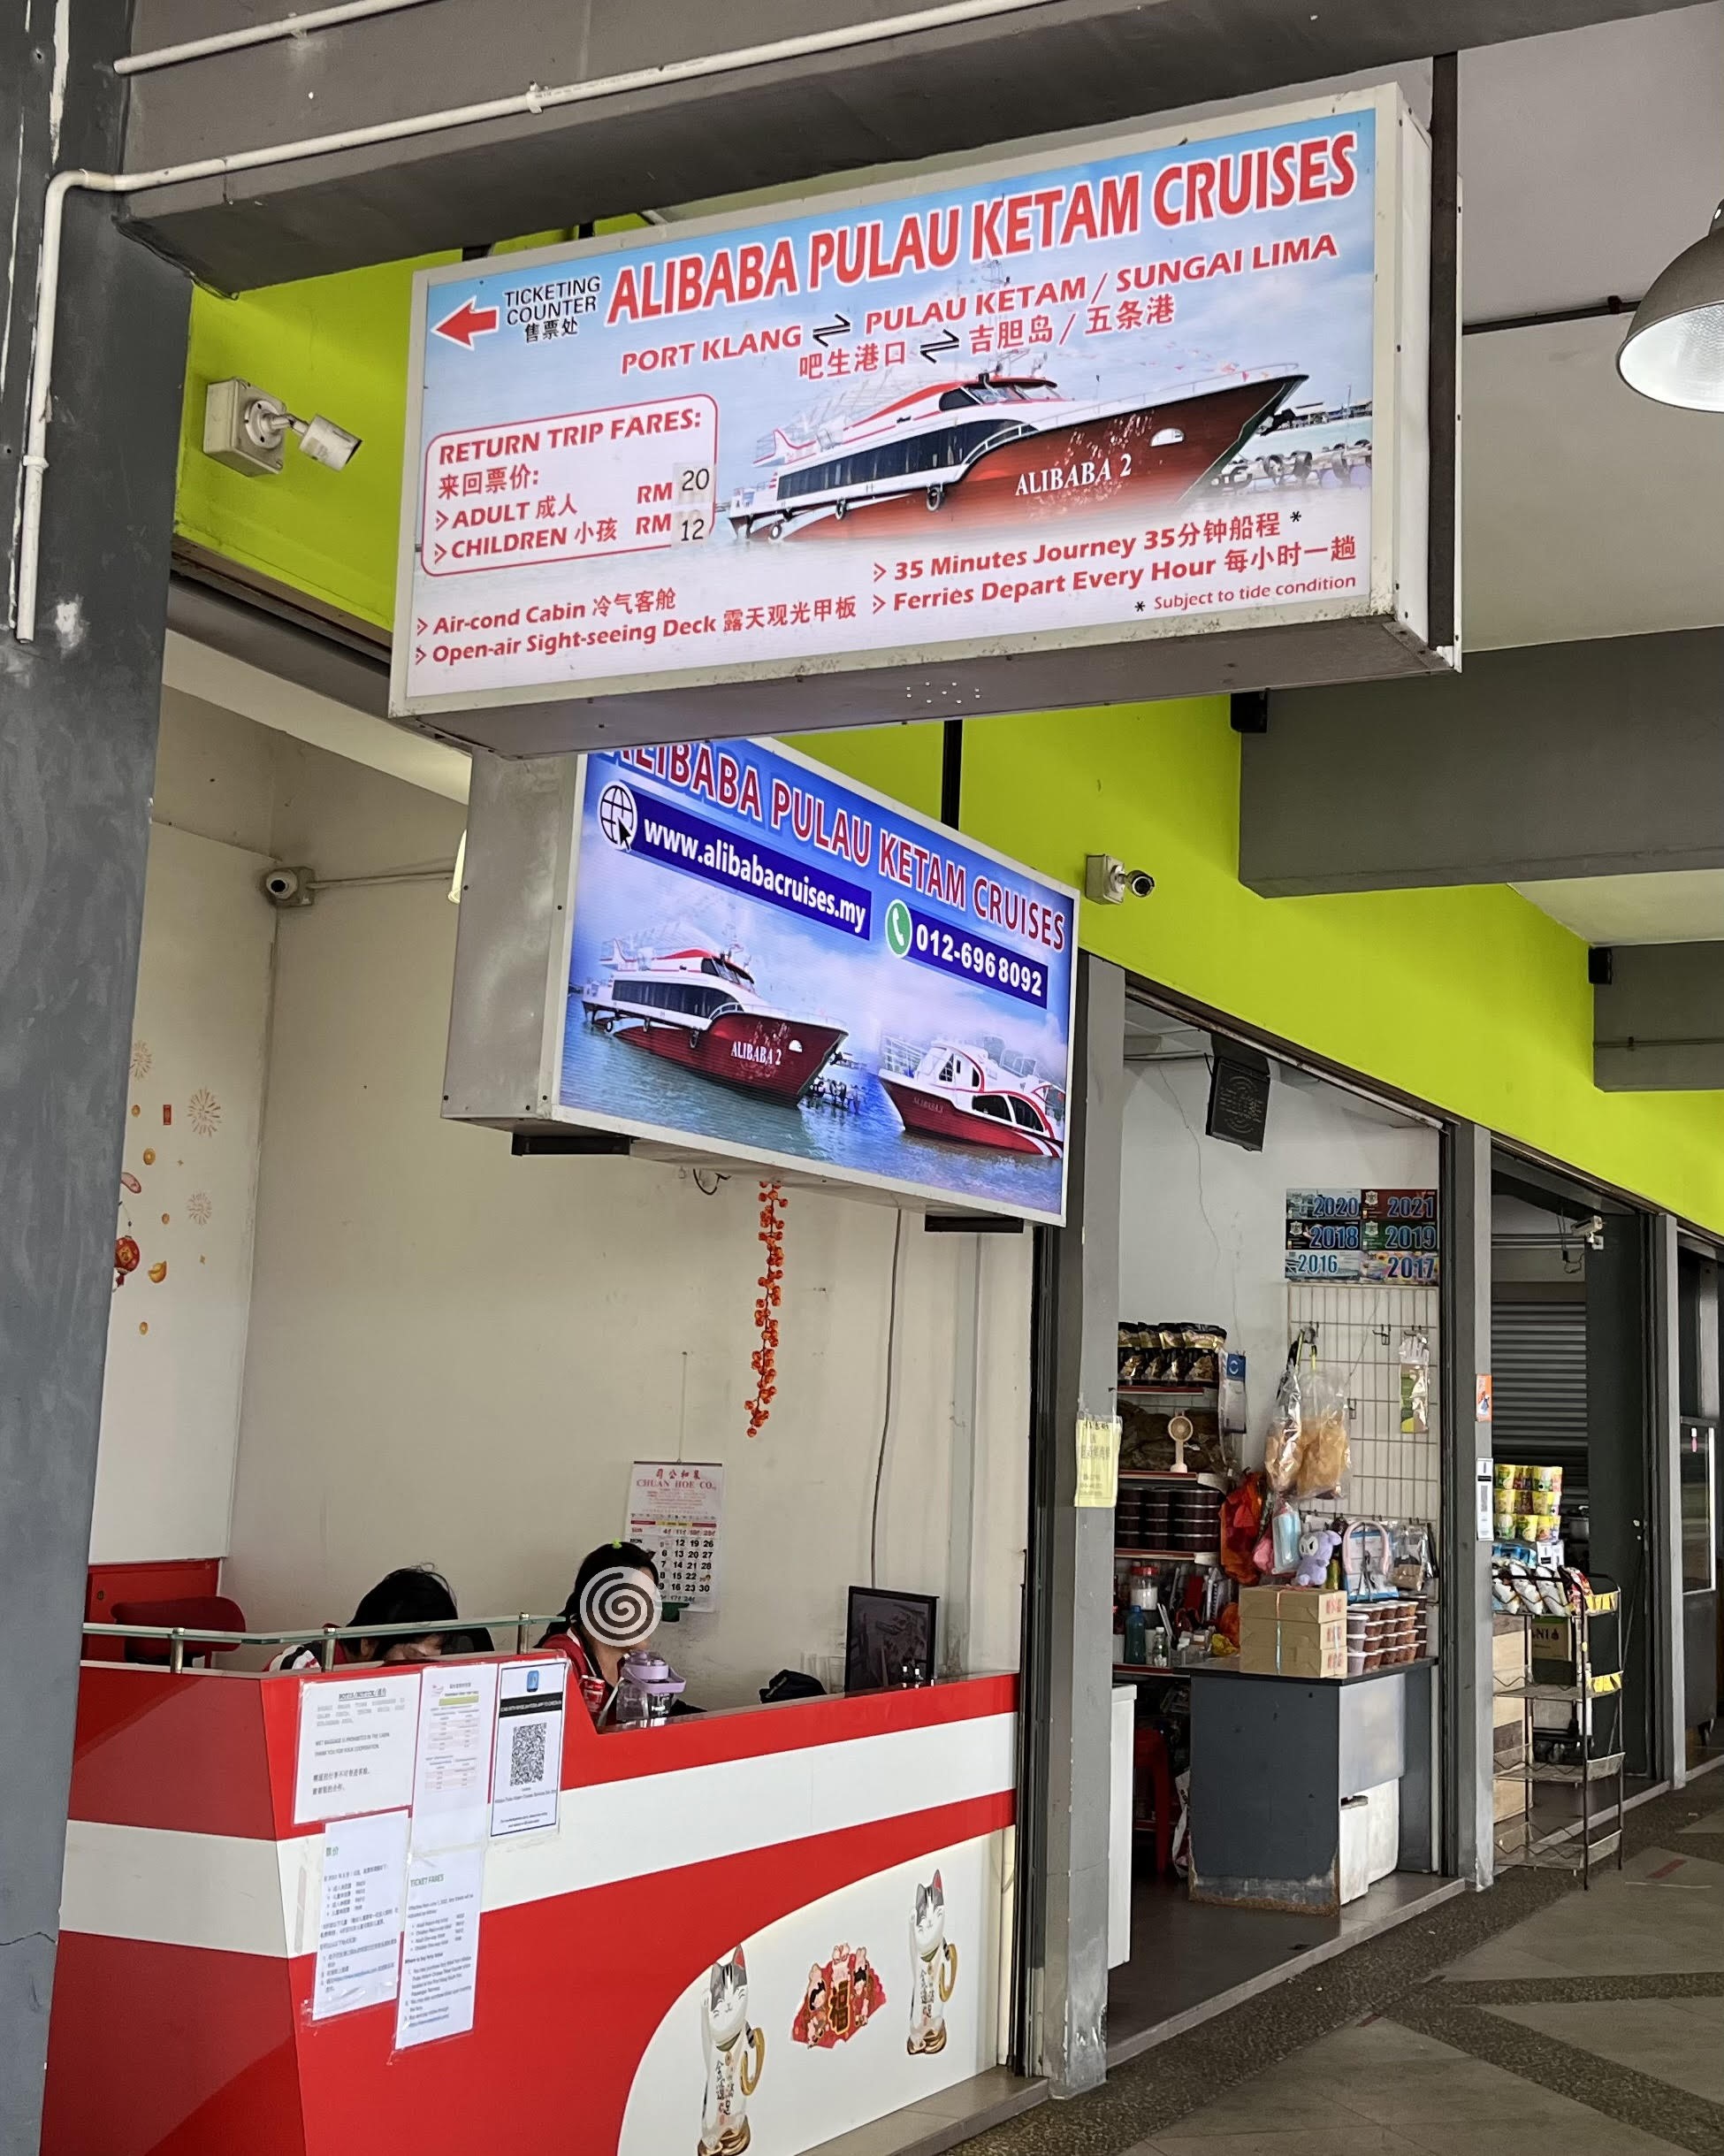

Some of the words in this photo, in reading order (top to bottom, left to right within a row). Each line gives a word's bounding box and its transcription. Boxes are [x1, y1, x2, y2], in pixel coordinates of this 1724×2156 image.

[607, 241, 797, 325] ALIBABA
[810, 209, 959, 290] PULAU
[973, 174, 1140, 260] KETAM
[1153, 134, 1357, 226] CRUISES
[505, 275, 601, 308] TICKETING
[622, 343, 695, 374] PORT
[703, 325, 802, 363] KLANG
[865, 297, 966, 335] PULAU
[975, 277, 1087, 317] KETAM
[1117, 249, 1243, 292] SUNGAI
[1252, 233, 1338, 270] LIMA
[507, 296, 598, 325] COUNTER
[525, 318, 578, 344] 售票处
[799, 340, 905, 380] 吧生港口
[969, 315, 1054, 355] 吉胆岛
[1085, 294, 1175, 335] 五条港
[439, 432, 539, 465] RETURN
[548, 423, 603, 449] TRIP
[611, 409, 701, 440] FARES:
[1015, 458, 1111, 496] ALIBABA
[1119, 453, 1132, 477] 2
[452, 501, 530, 529] ADULT
[536, 493, 577, 520] 成人
[637, 482, 673, 504] RM
[682, 468, 709, 492] 20
[451, 527, 567, 559] CHILDREN
[574, 518, 617, 545] 小孩
[636, 514, 672, 535] RM
[681, 519, 705, 541] 12
[894, 560, 923, 580] 35
[931, 548, 1026, 576] Minutes
[1034, 536, 1136, 566] Journey
[894, 586, 973, 611] Ferries
[981, 575, 1065, 603] Depart
[1073, 564, 1144, 592] Every
[1151, 557, 1216, 582] Hour
[1224, 536, 1356, 573] 每小时一趟
[432, 608, 520, 635] Air-cond
[525, 602, 586, 624] Cabin
[592, 587, 676, 617] 冷气客舱
[1154, 591, 1213, 611] Subject
[1218, 588, 1233, 603] to
[1240, 583, 1270, 600] tide
[1276, 575, 1356, 596] condition
[432, 640, 521, 666] Open-air
[526, 623, 656, 656] Sight-seeing
[663, 615, 716, 638] Deck
[722, 596, 857, 633] 露天观光甲板
[622, 744, 761, 818] LIBABA
[773, 783, 871, 865] PULAU
[880, 830, 965, 909] KETAM
[973, 878, 1064, 951] CRUISES
[645, 819, 866, 934] www.alibabacruises.my
[731, 1041, 773, 1066] ALIBABA
[775, 1048, 782, 1066] 2
[1312, 1197, 1360, 1218] 2020
[1387, 1197, 1434, 1218] 2021
[1308, 1226, 1359, 1250] 2018
[1385, 1225, 1437, 1250] 2019
[1298, 1254, 1338, 1274] 2016
[1387, 1256, 1436, 1280] 2017
[636, 1479, 669, 1487] CHUAN
[672, 1571, 683, 1580] 15
[700, 1562, 712, 1571] 28
